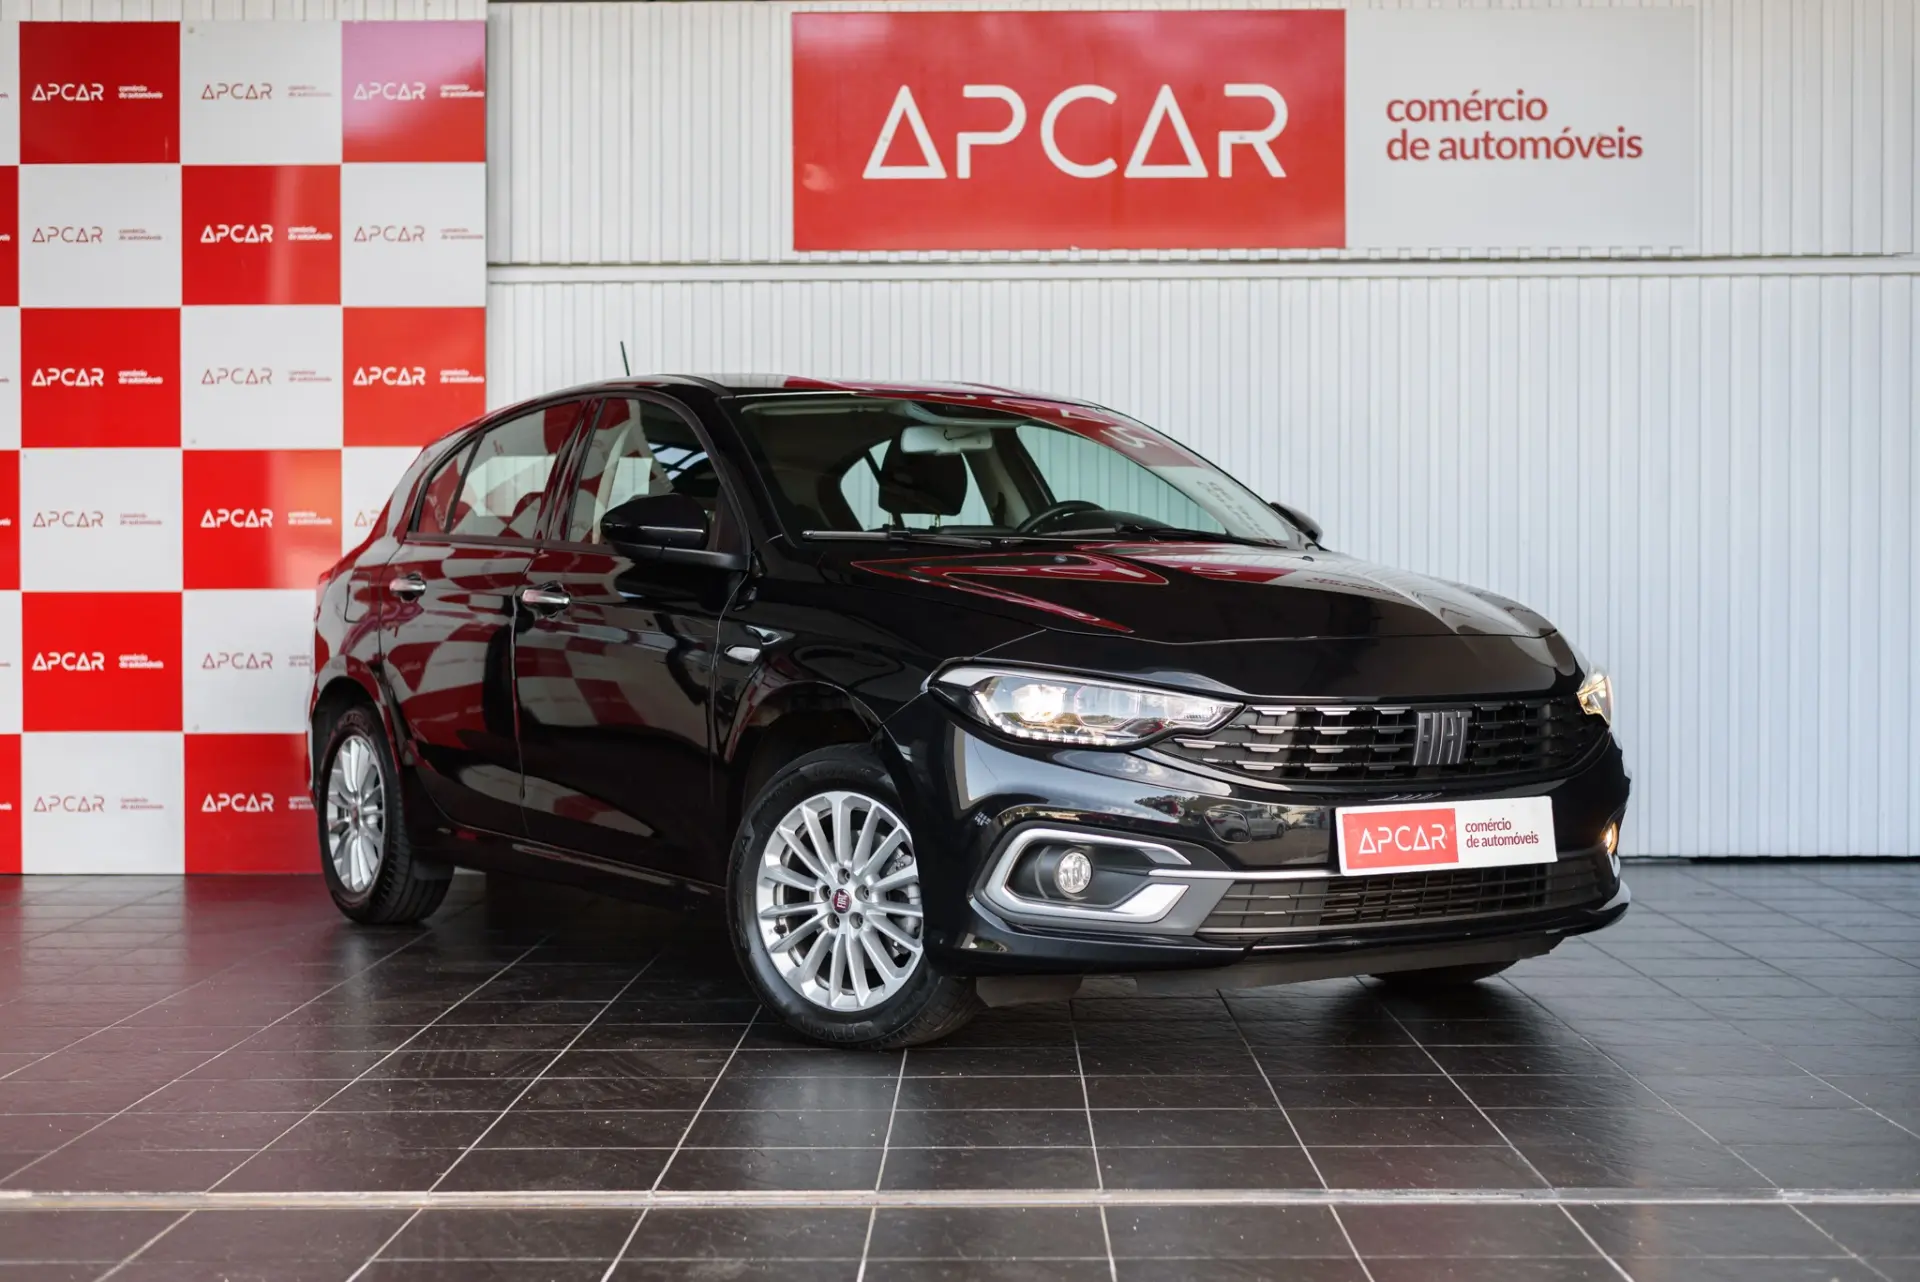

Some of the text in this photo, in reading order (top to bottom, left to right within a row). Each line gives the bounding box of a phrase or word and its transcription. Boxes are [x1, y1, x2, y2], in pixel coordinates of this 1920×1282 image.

[32, 83, 104, 101] APCAR
[201, 83, 272, 100] APCAR
[353, 82, 425, 100] APCAR
[1386, 89, 1548, 122] comércio
[863, 84, 1288, 179] APCAR
[1387, 126, 1643, 161] de automóveis
[32, 226, 103, 243] APCAR
[200, 224, 273, 243] APCAR
[354, 225, 425, 242] APCAR
[31, 368, 104, 386] APCAR
[201, 368, 272, 385] APCAR
[353, 367, 425, 386] APCAR
[33, 511, 103, 528] APCAR
[200, 509, 273, 528] APCAR
[32, 652, 104, 671] APCAR
[202, 652, 273, 669] APCAR
[1413, 711, 1472, 766] FIAT
[34, 795, 104, 812] APCAR
[202, 793, 274, 812] APCAR
[1465, 818, 1512, 833] comércio
[1359, 824, 1446, 854] APCAR
[1466, 831, 1539, 848] de automóveis
